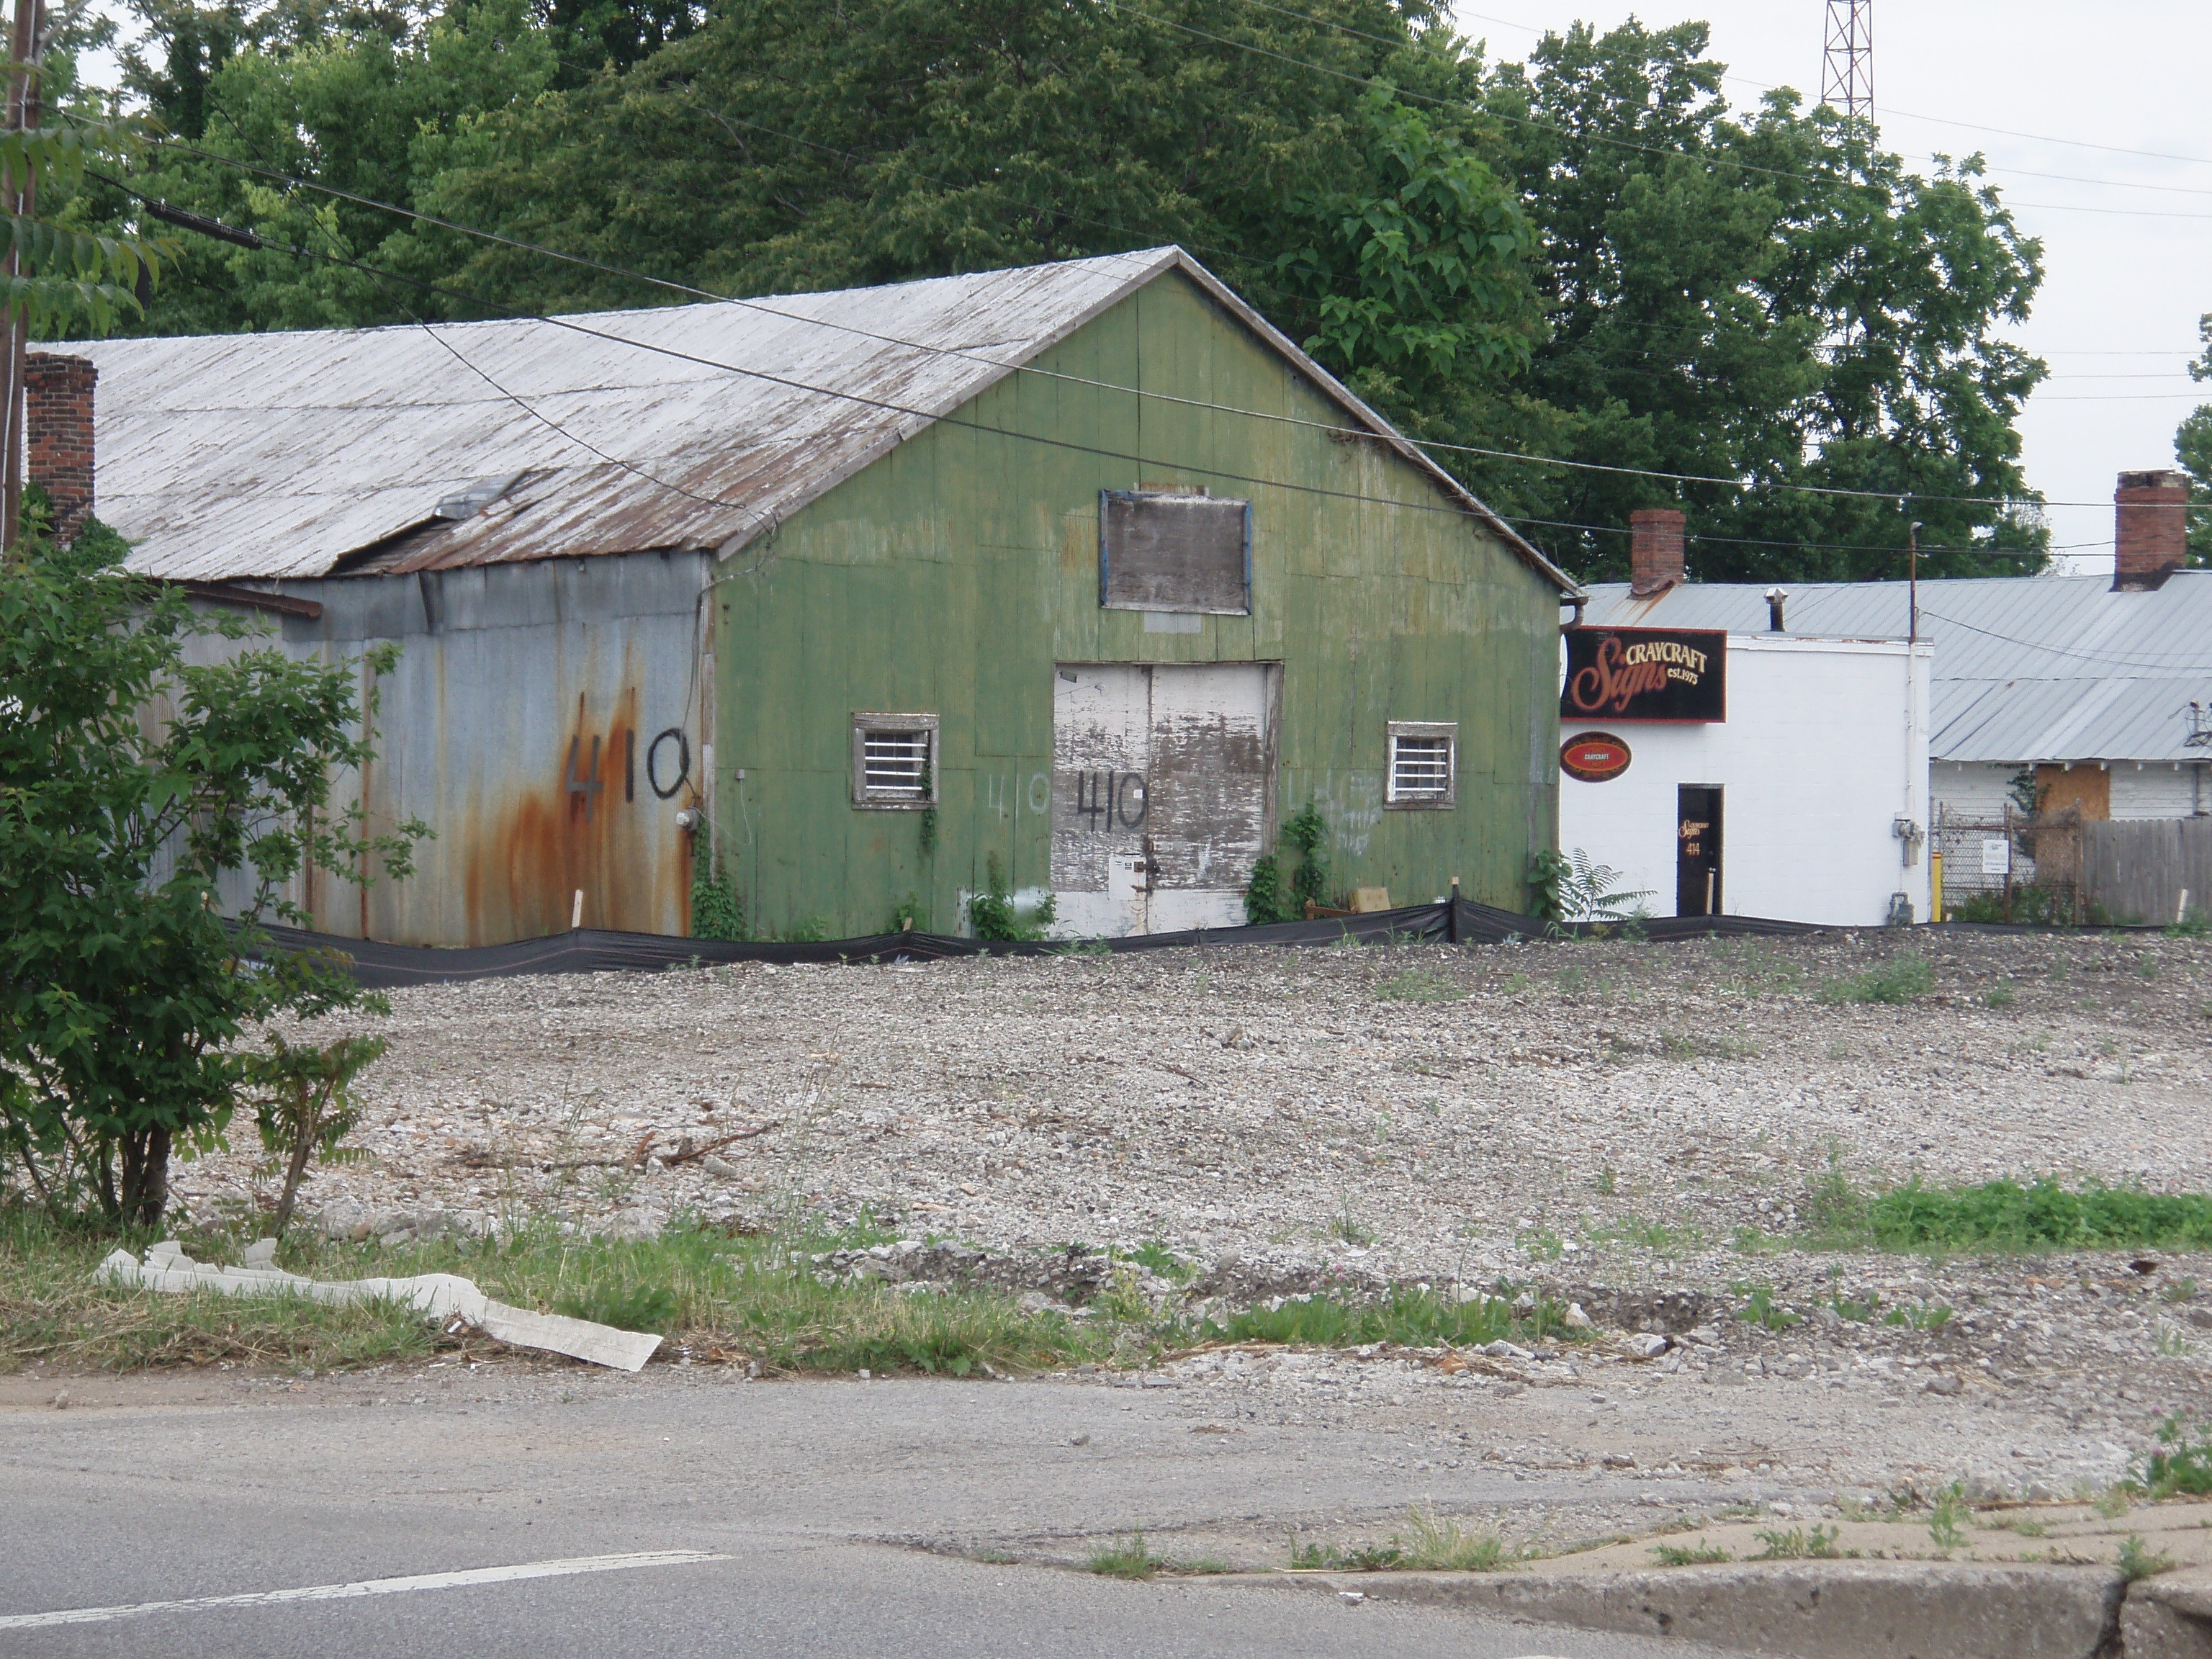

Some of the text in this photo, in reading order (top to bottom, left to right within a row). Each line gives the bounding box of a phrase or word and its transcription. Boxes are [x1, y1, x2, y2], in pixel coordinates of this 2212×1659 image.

[1572, 637, 1667, 712] Signs
[1626, 642, 1707, 673] CRAYCRAFT
[1667, 666, 1699, 685] est.1975
[566, 727, 689, 823] 410
[988, 771, 1050, 827] 410
[1078, 769, 1149, 833] 410
